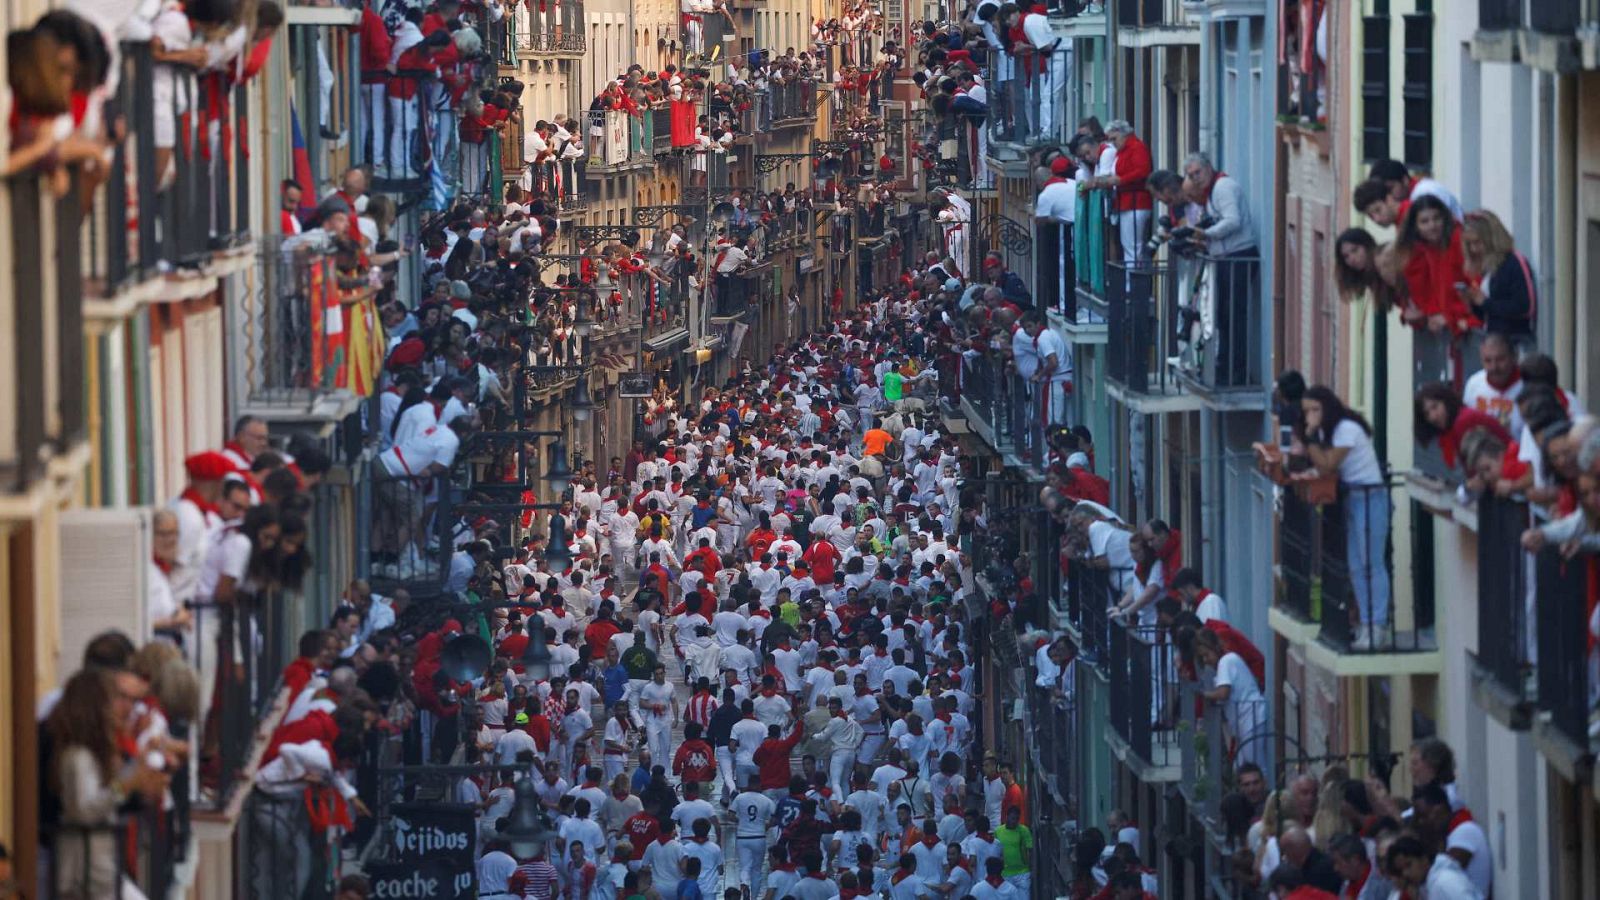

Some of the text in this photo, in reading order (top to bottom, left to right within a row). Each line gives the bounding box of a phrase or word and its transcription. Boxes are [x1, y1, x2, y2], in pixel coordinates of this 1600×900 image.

[726, 572, 735, 585] 7
[747, 804, 758, 822] 9
[391, 816, 468, 855] Tejidos
[367, 871, 438, 898] eache
